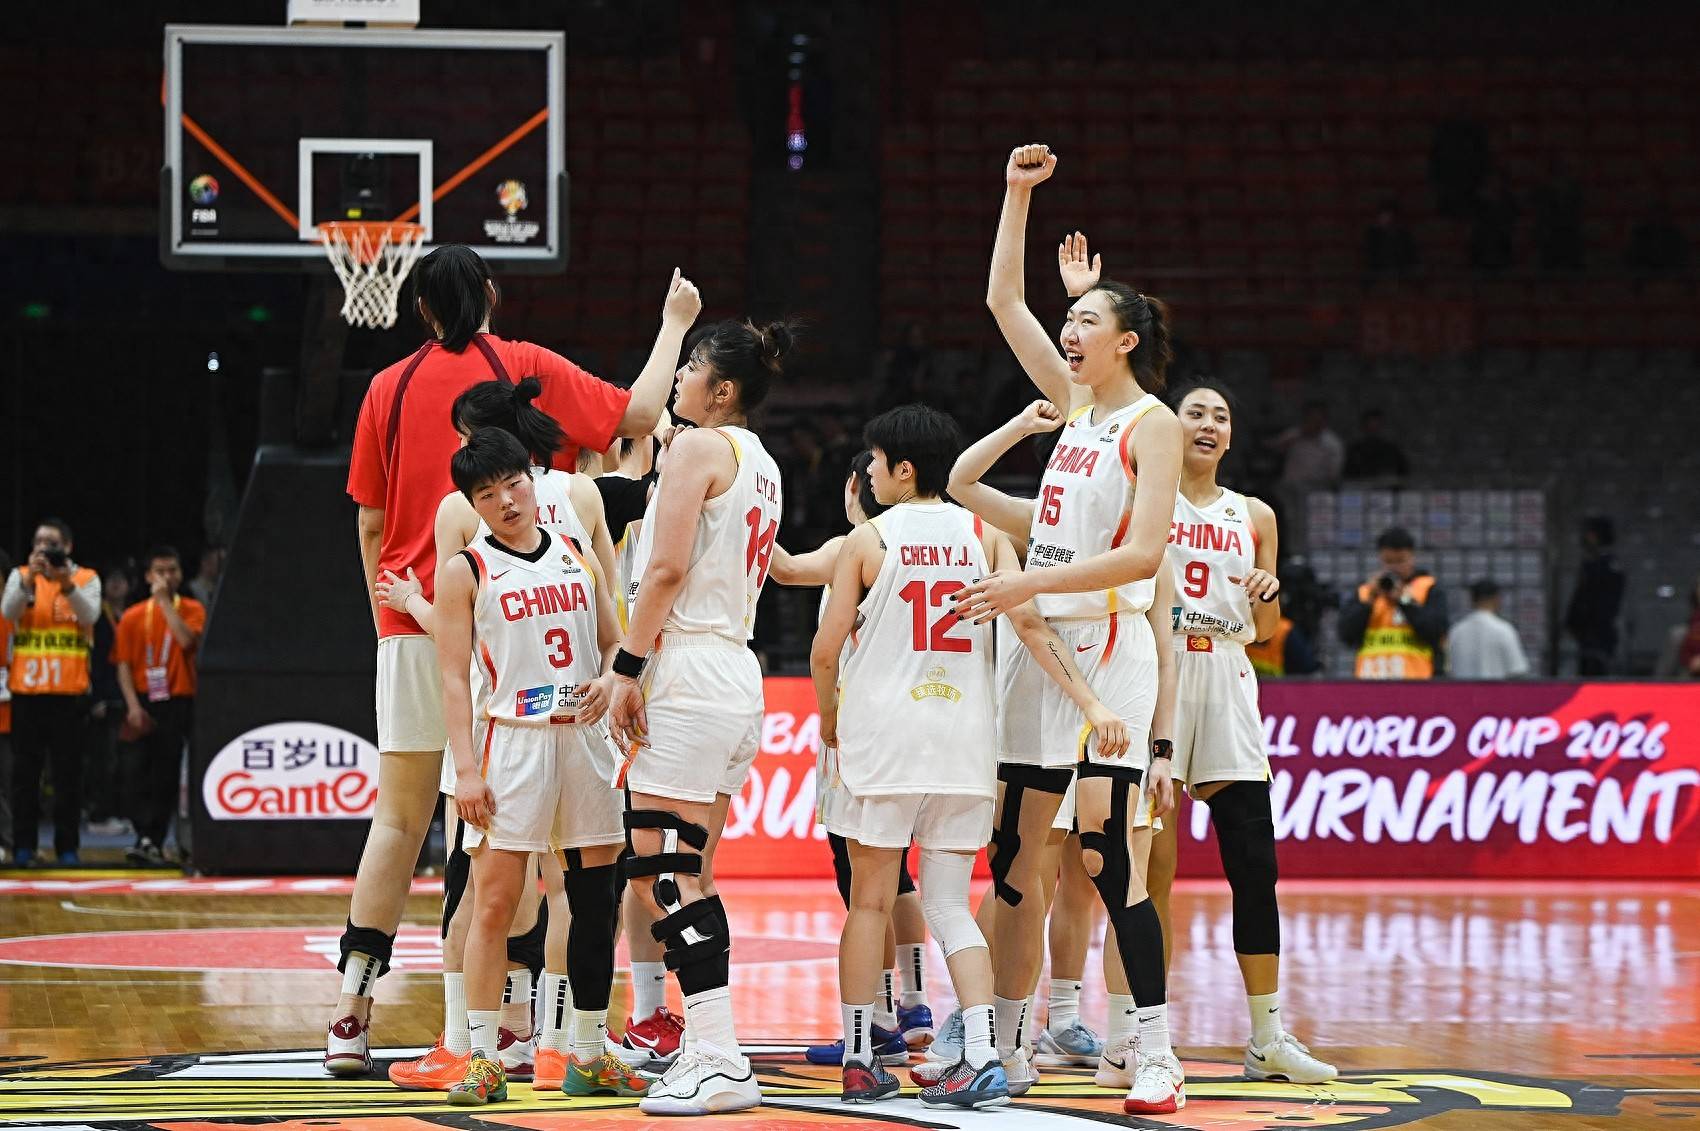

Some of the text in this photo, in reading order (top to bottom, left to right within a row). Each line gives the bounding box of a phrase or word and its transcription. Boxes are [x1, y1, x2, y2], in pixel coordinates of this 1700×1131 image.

[1039, 484, 1064, 527] 15
[746, 506, 778, 589] 14
[900, 545, 973, 566] CHEN Y.J.
[1184, 561, 1210, 599] 9
[500, 583, 588, 622] CHINA
[899, 580, 972, 653] 12
[544, 627, 574, 669] 3
[243, 737, 359, 771] 百岁山
[1312, 714, 1456, 758] WORLD
[1467, 715, 1561, 759] CUP
[1565, 719, 1670, 760] 2026
[216, 771, 379, 815] Gante
[1191, 767, 1700, 844] URNAMENT
